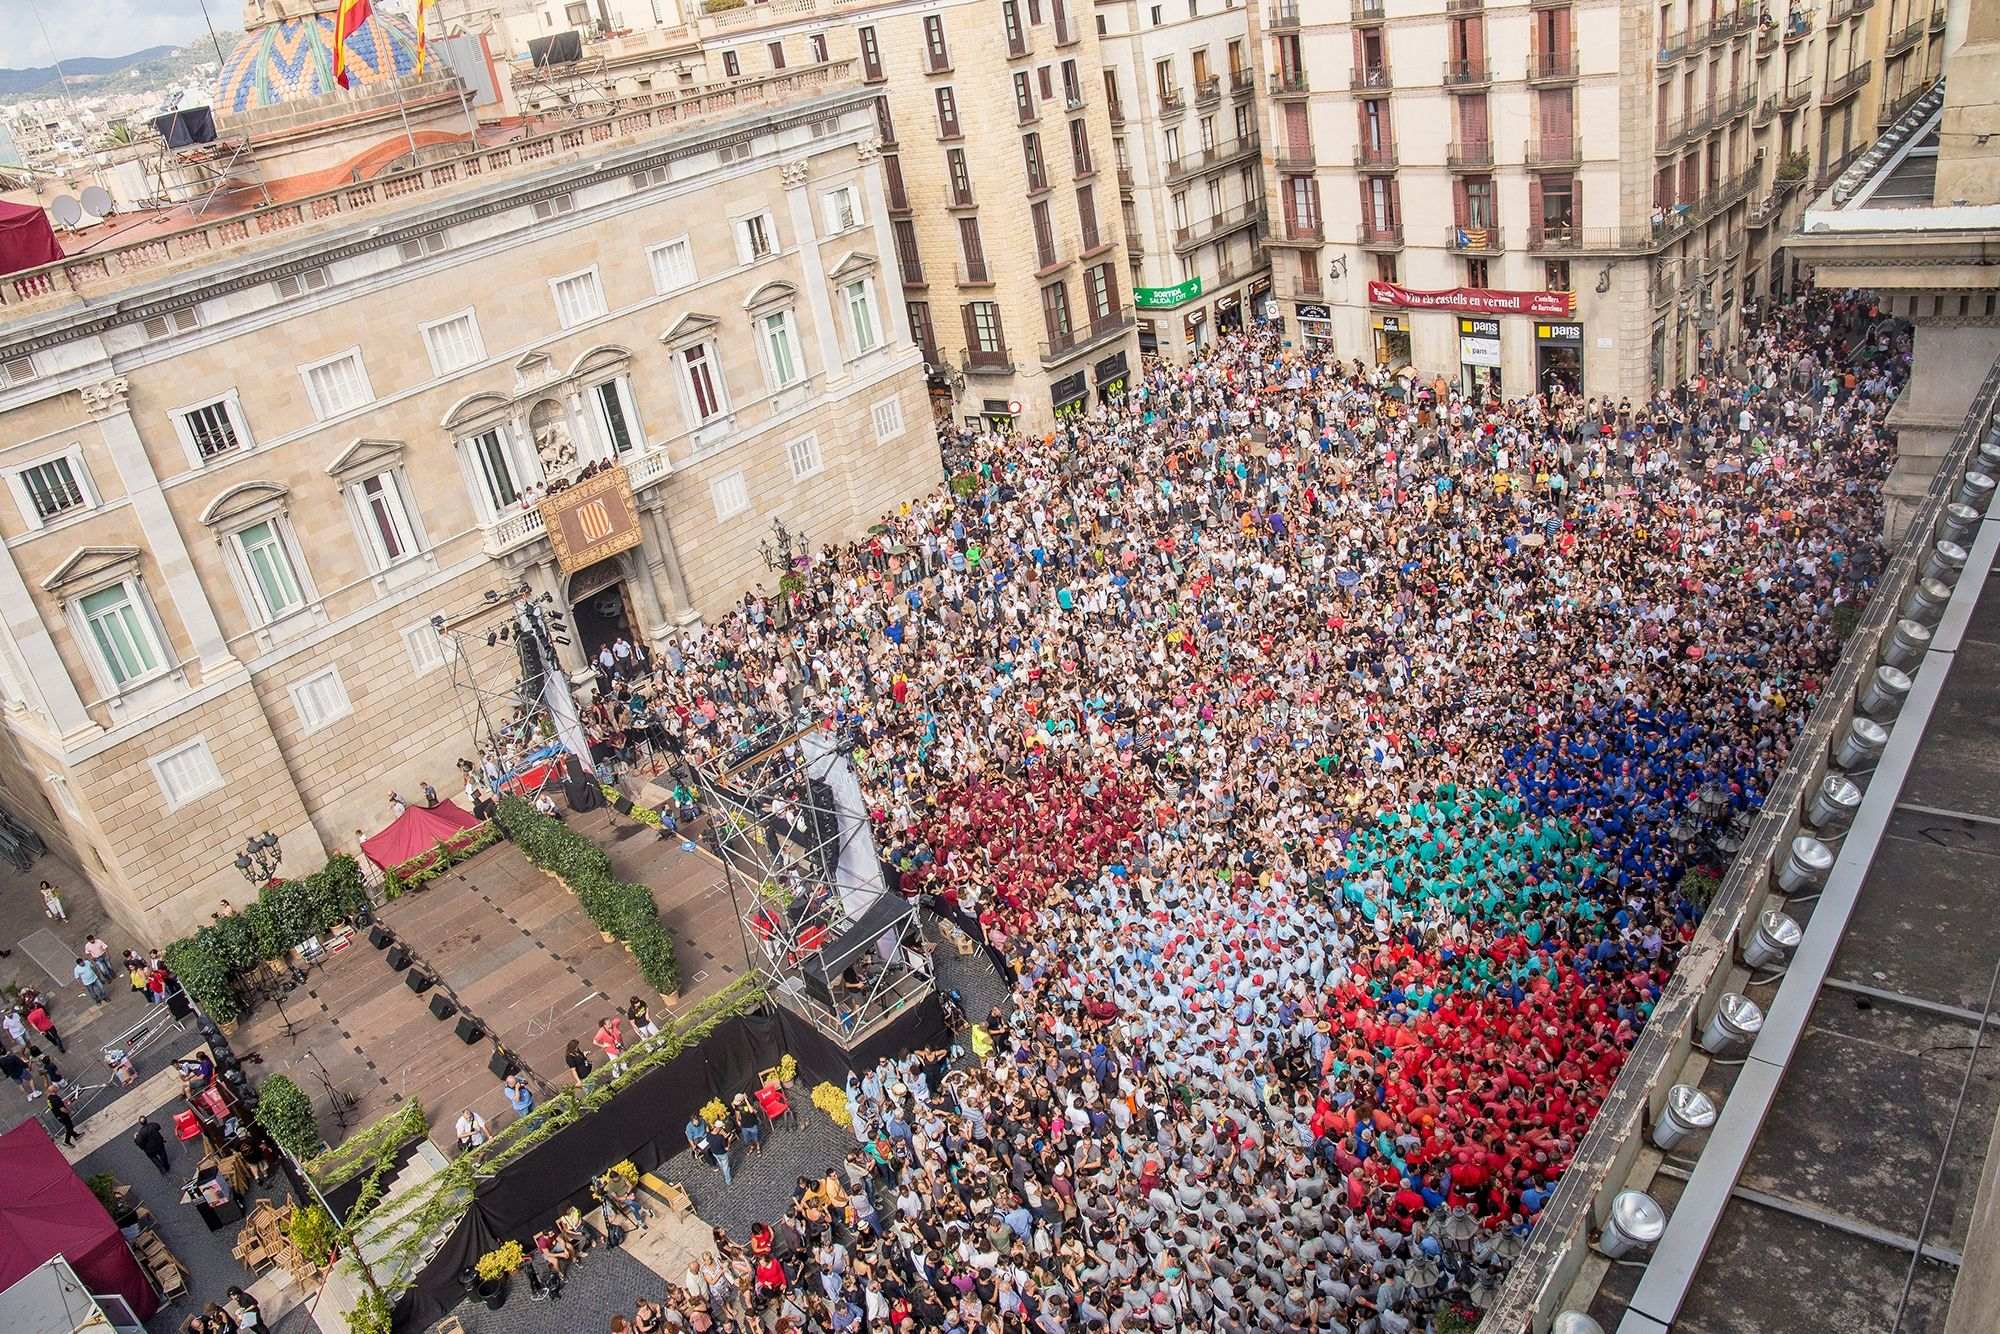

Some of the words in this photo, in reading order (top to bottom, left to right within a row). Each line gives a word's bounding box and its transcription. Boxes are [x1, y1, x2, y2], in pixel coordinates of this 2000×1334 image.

[1153, 288, 1182, 298] SORTIDA
[1435, 293, 1468, 305] castells
[1470, 296, 1480, 306] en
[1483, 297, 1520, 308] vermell
[1534, 295, 1559, 304] Castellers
[1538, 304, 1563, 312] Barcelona
[1473, 321, 1498, 333] pans
[1552, 325, 1580, 338] pans
